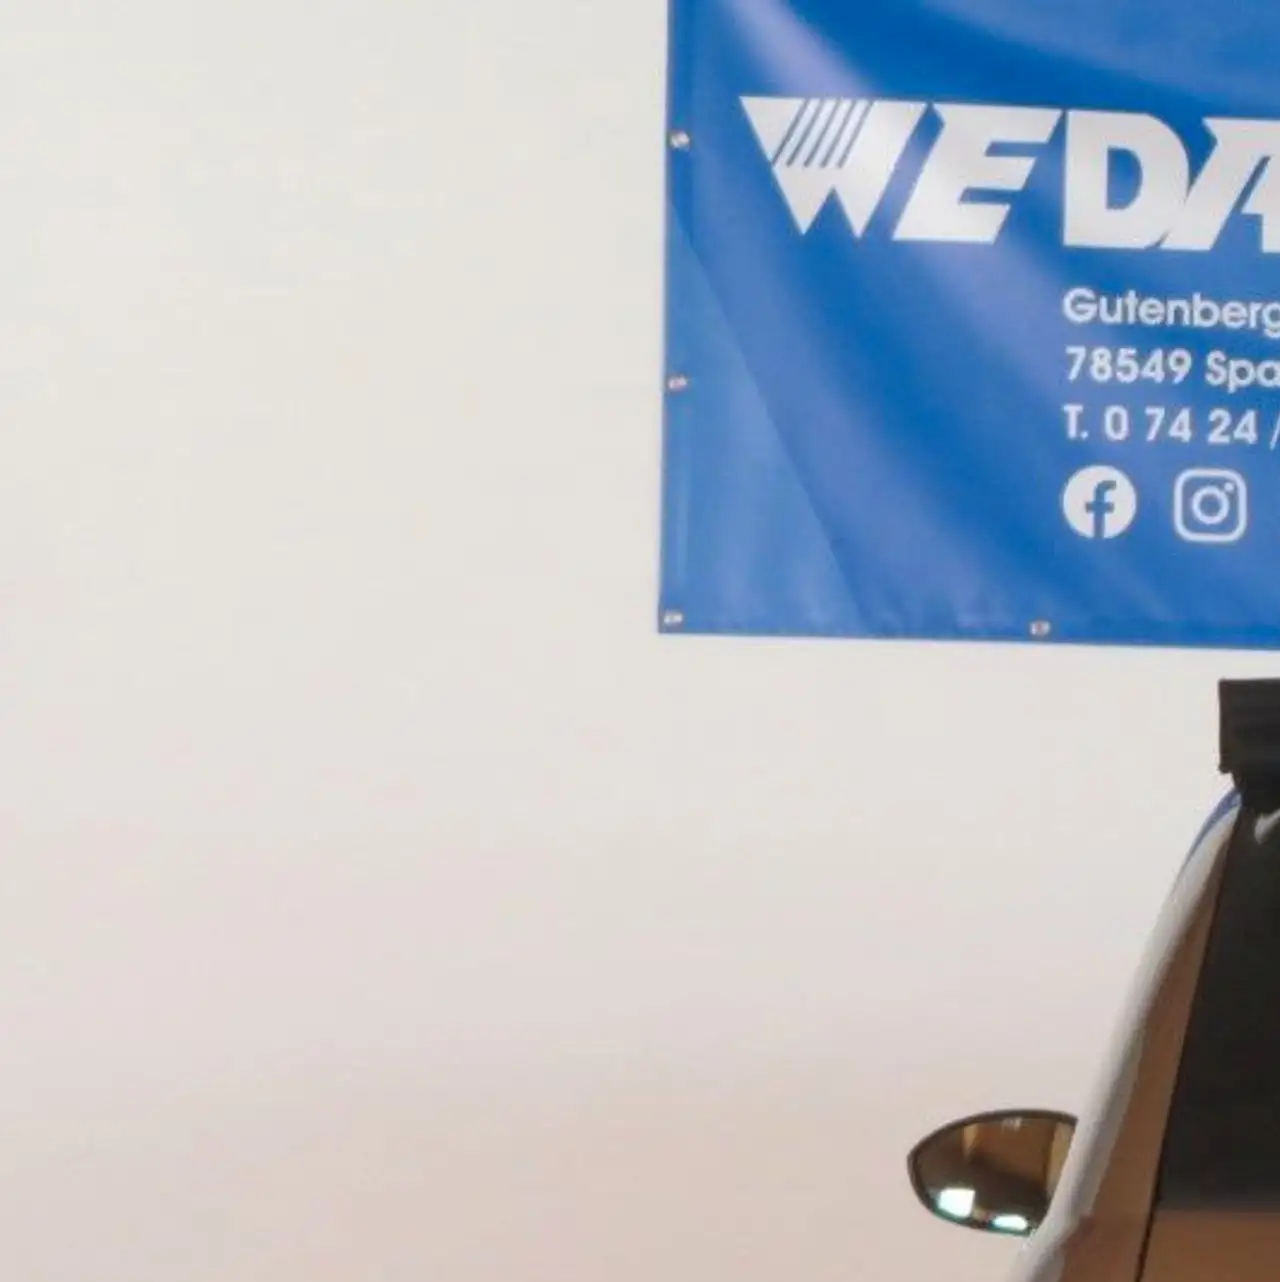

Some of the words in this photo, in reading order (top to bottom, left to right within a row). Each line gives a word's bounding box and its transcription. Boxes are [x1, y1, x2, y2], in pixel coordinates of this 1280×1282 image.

[1066, 346, 1192, 384] 78549
[1064, 405, 1088, 439] T.
[1104, 406, 1129, 441] 0
[1145, 407, 1192, 442] 74
[1208, 408, 1257, 444] 24
